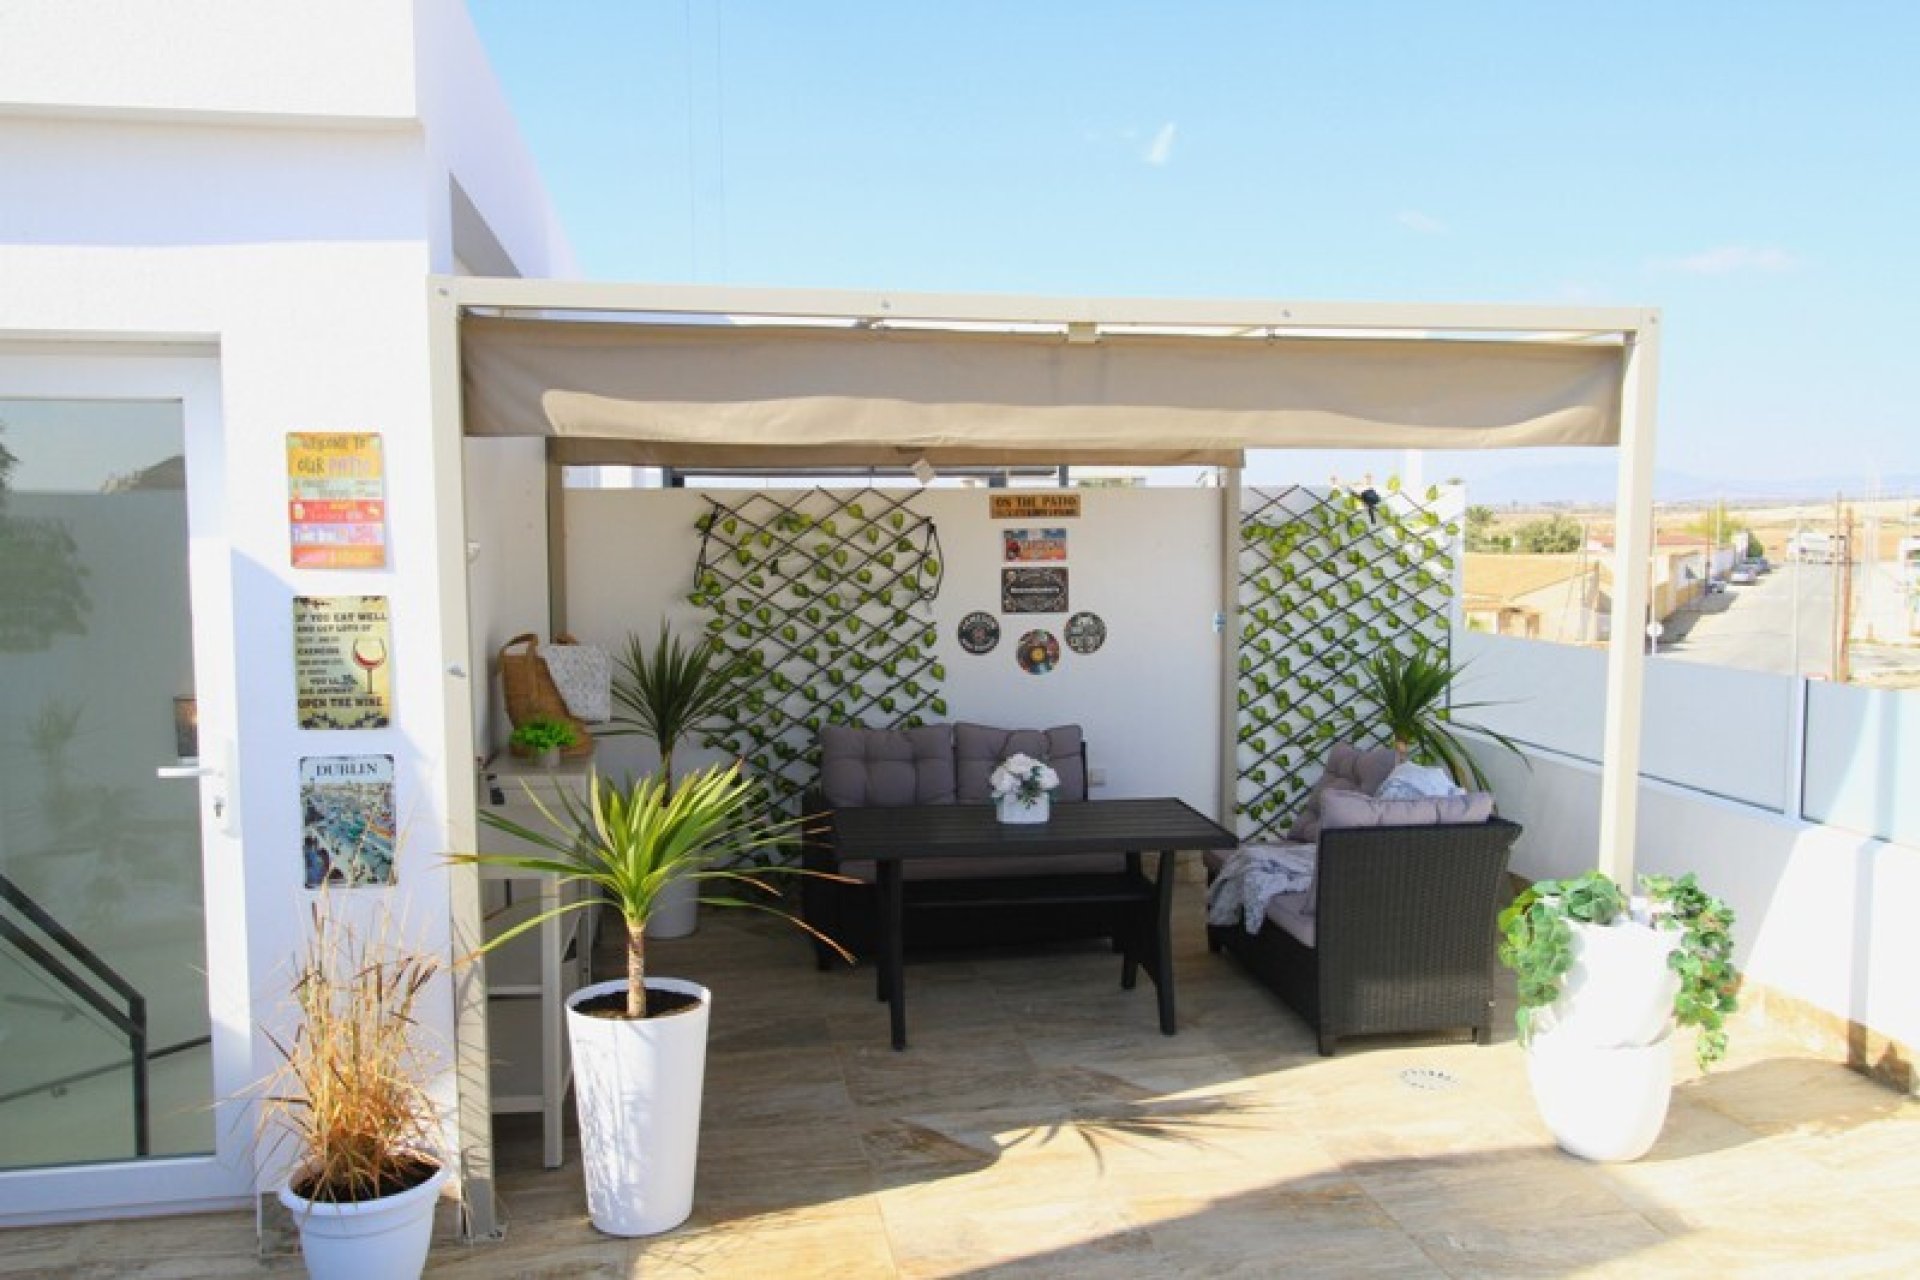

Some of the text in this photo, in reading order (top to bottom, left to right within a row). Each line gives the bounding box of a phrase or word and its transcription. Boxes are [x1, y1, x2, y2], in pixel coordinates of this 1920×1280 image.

[996, 496, 1078, 507] ON THE PATIO
[358, 612, 387, 622] WELL
[298, 697, 383, 708] OPEN THE WINE
[316, 763, 378, 777] DUBLIN
